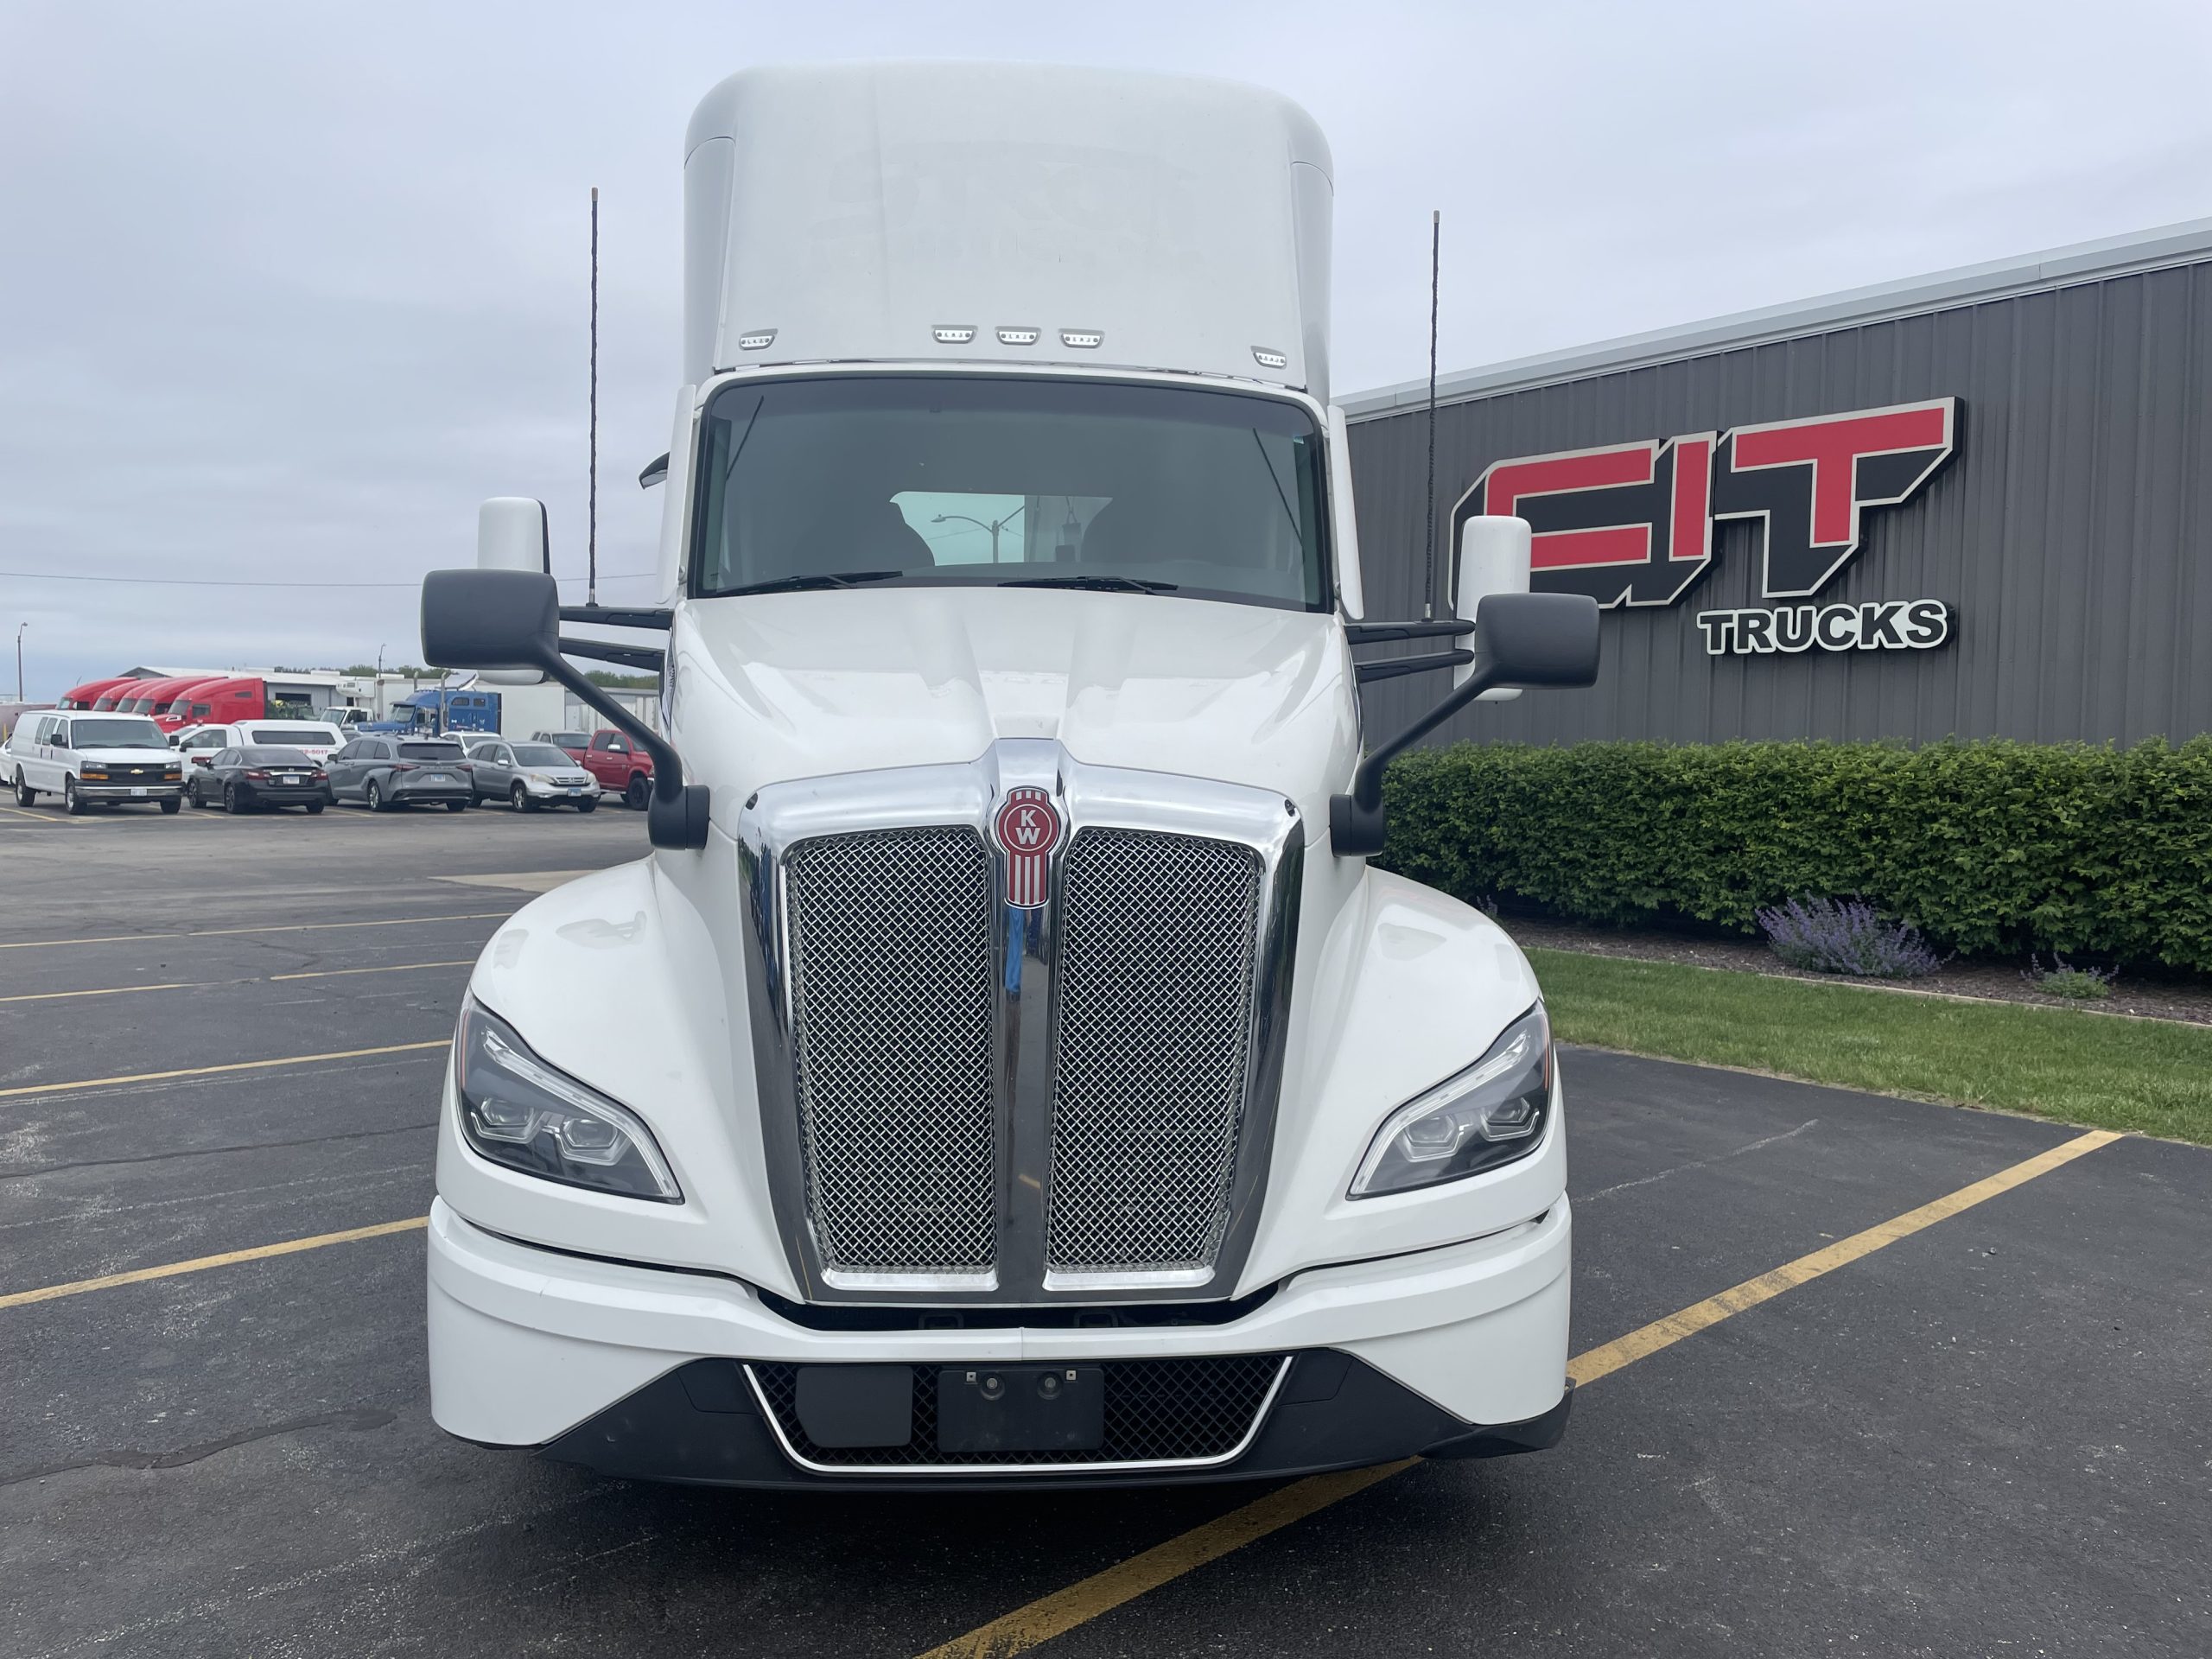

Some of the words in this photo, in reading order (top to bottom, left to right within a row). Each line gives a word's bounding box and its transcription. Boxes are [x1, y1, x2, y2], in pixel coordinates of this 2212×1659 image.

[1450, 397, 1955, 608] CIT
[1698, 600, 1949, 654] TRUCKS
[1015, 827, 1041, 845] W
[1020, 810, 1037, 827] K
